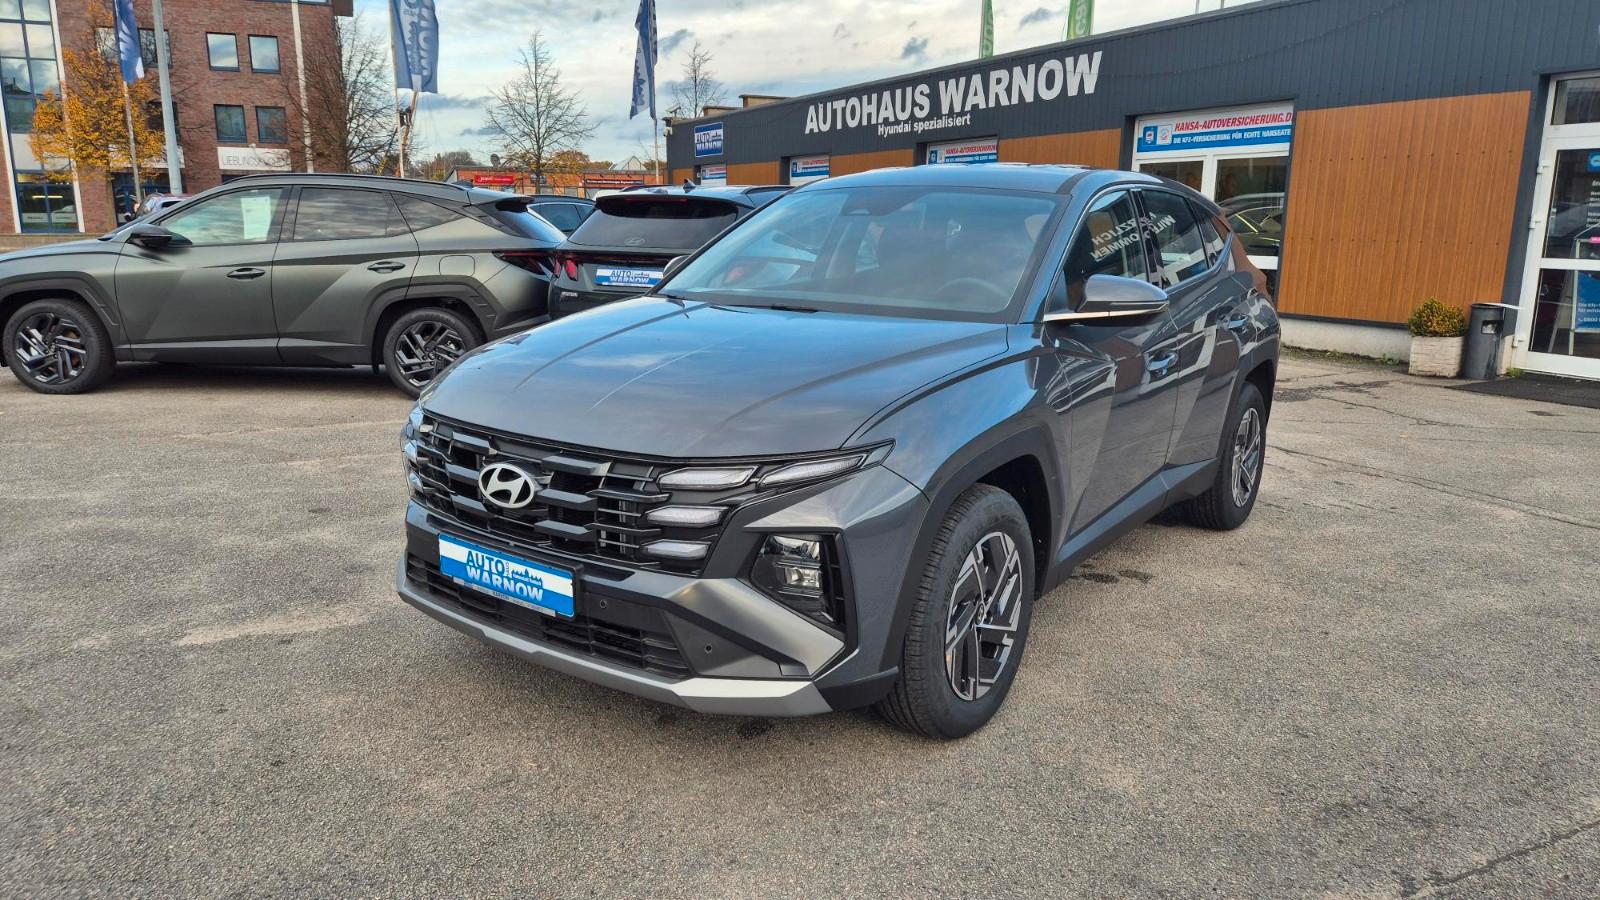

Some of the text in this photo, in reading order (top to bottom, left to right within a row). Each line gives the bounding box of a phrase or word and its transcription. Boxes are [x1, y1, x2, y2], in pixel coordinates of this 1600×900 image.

[805, 51, 1103, 134] AUTOHAUS WARNOW
[877, 113, 971, 138] Hyundai spezialisiert
[609, 276, 649, 284] WARNOW
[610, 270, 632, 278] AUTO
[466, 550, 505, 576] AUTO
[466, 565, 544, 602] WARNOW
